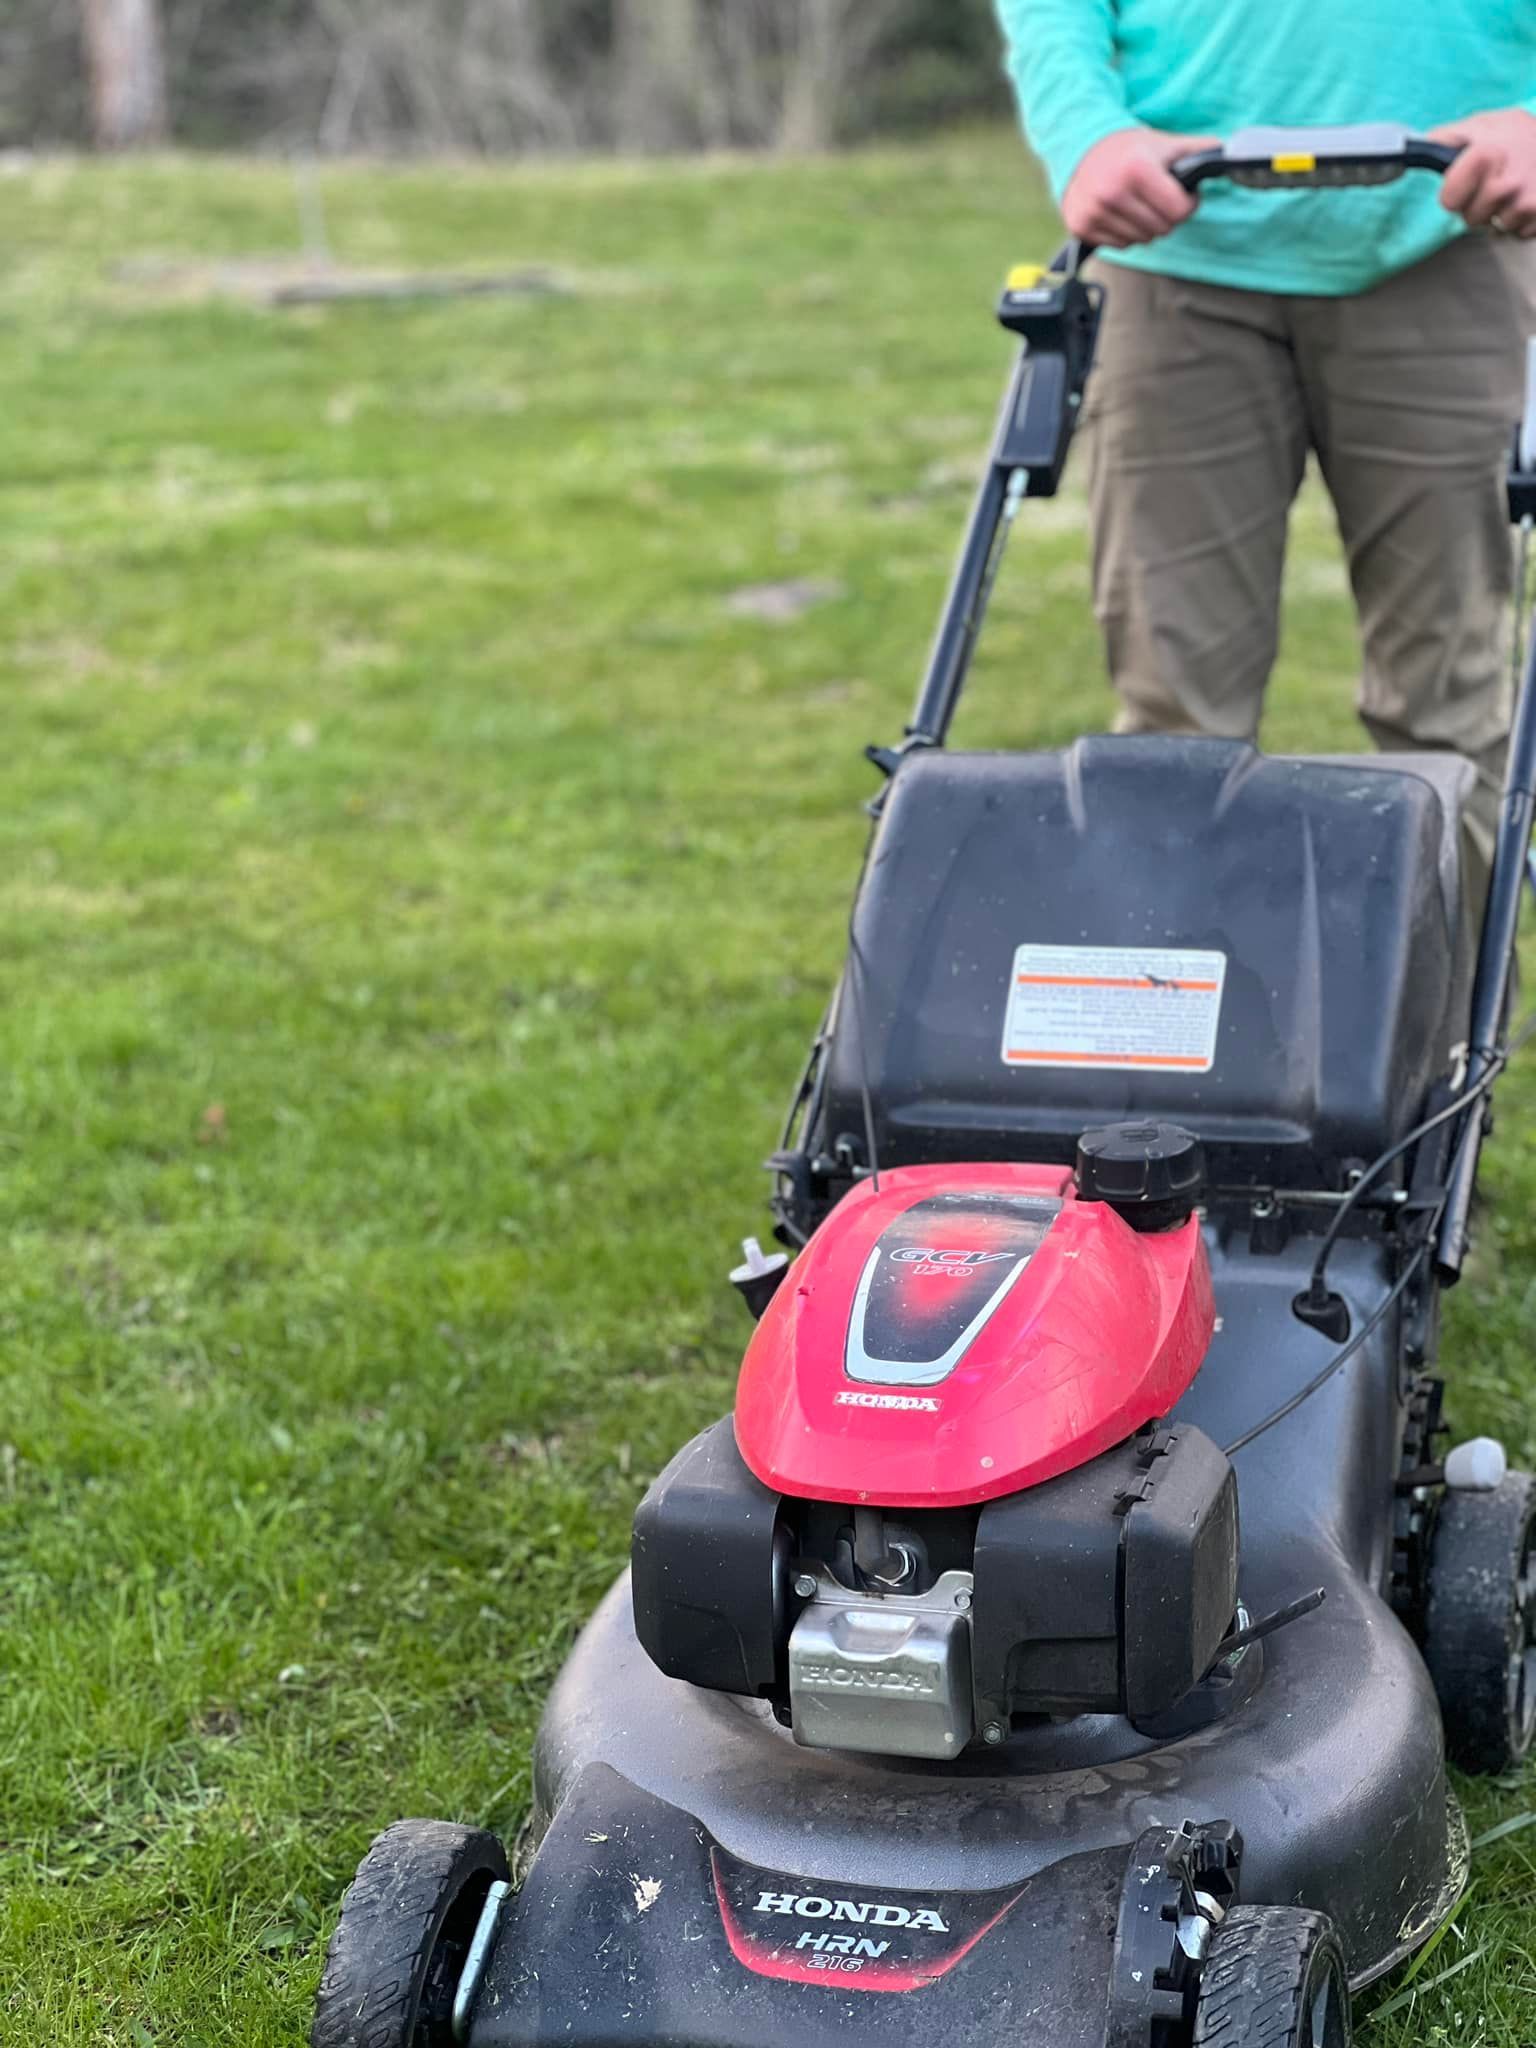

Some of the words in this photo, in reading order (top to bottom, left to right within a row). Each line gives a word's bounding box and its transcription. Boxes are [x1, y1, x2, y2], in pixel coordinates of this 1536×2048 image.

[889, 1247, 1016, 1265] GCV
[912, 1264, 973, 1277] 170
[836, 1391, 939, 1411] HONDA
[800, 1664, 934, 1693] HONDA
[752, 1891, 950, 1932] HONDA
[795, 1932, 889, 1958] HRN
[806, 1954, 864, 1973] 216
